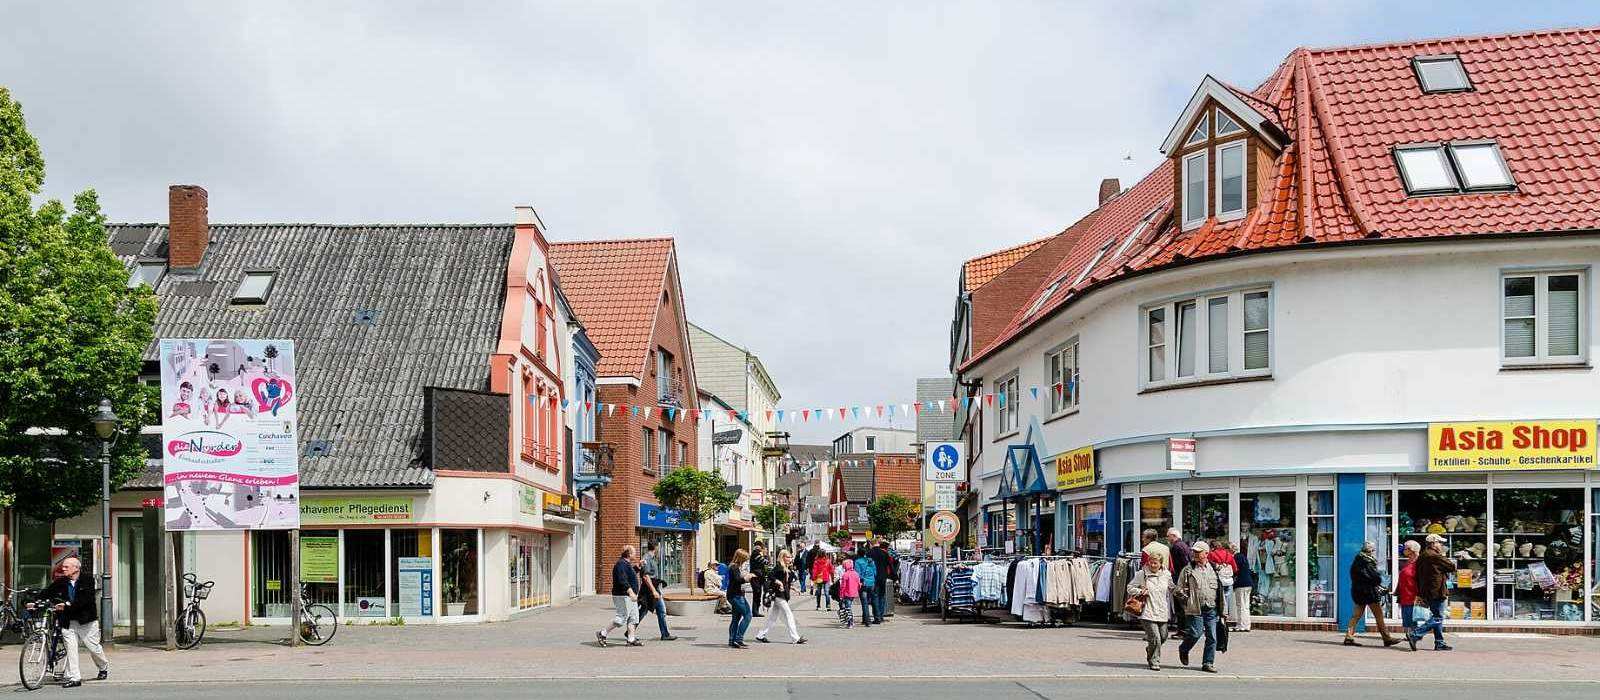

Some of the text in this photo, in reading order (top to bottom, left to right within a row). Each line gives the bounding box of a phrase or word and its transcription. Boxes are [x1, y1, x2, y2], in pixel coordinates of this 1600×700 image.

[1439, 425, 1588, 452] Asia Shop
[1057, 452, 1091, 476] Asia Shop
[1434, 455, 1593, 466] Textilien Schuhe Geschenkartikel
[935, 471, 956, 479] ZONE
[349, 504, 409, 515] Pflegedienst
